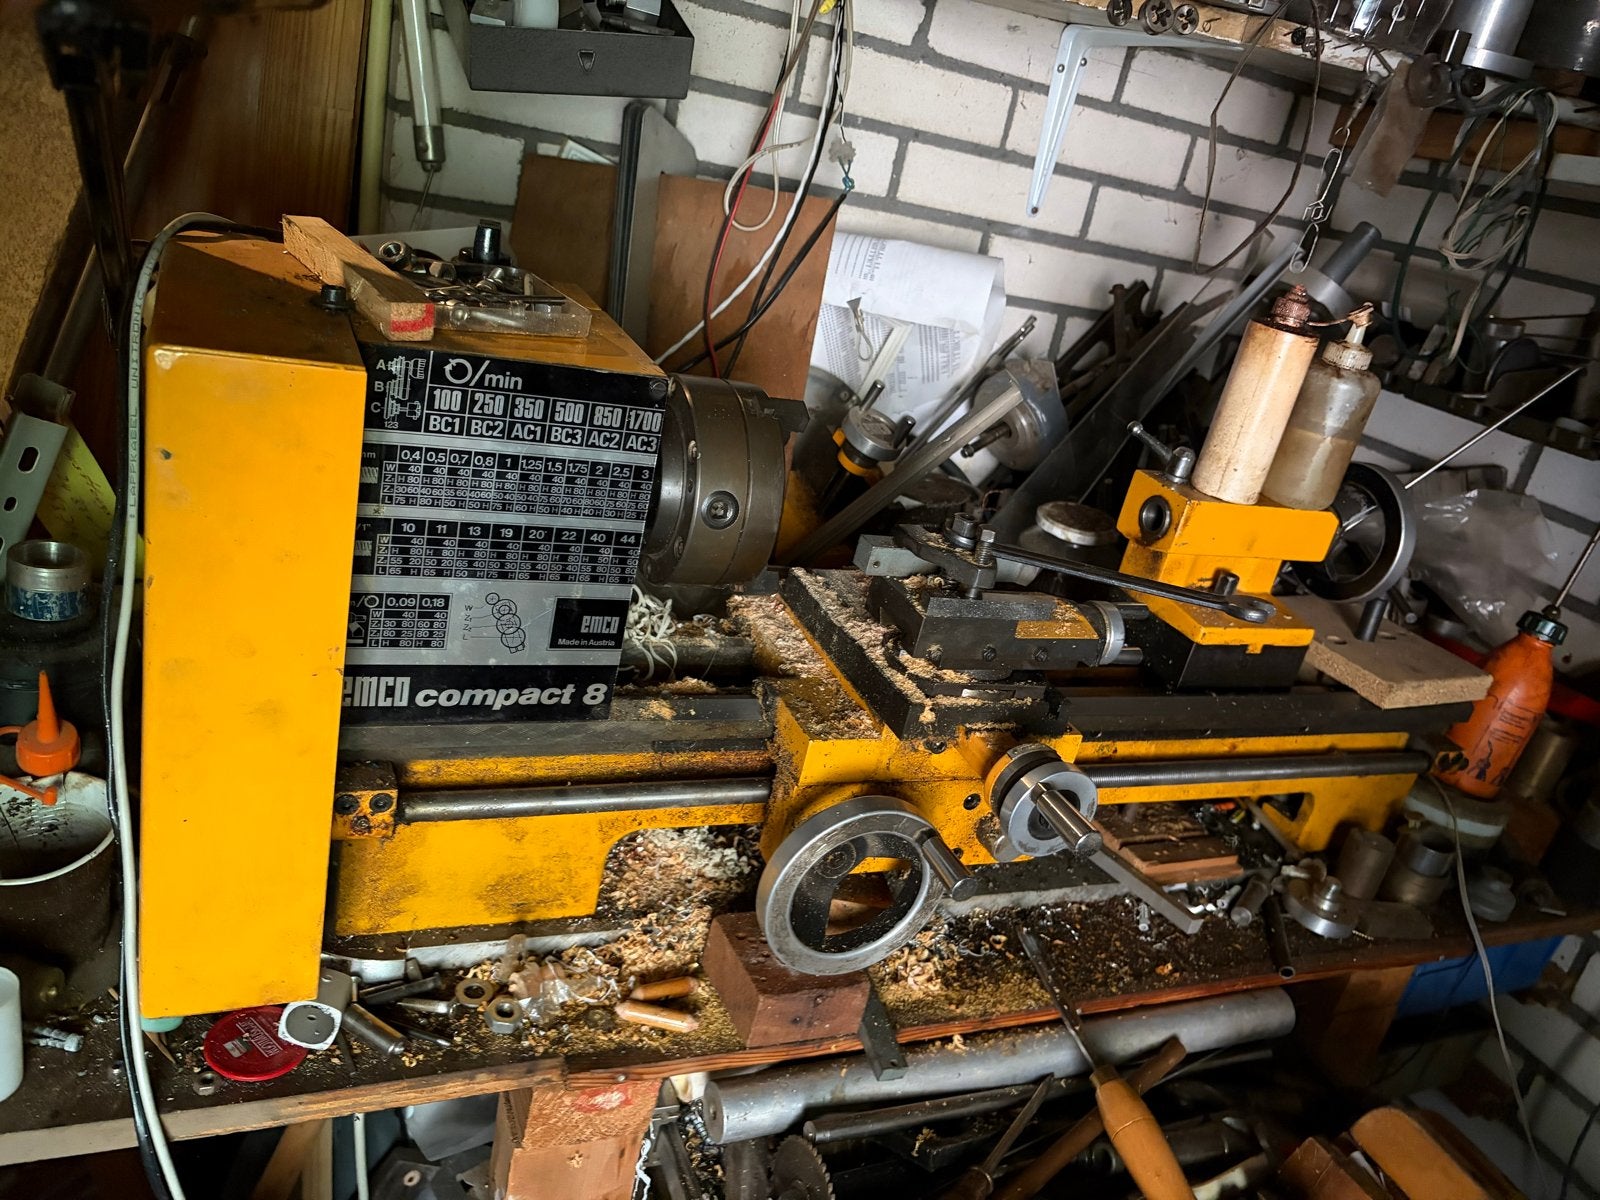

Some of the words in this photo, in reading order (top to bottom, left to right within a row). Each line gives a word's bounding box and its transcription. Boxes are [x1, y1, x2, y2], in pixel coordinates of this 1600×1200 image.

[131, 290, 146, 389] UNITRONIC
[376, 359, 386, 370] A
[374, 381, 384, 392] B
[371, 402, 381, 413] C
[433, 388, 462, 412] 100
[472, 392, 505, 416] 250
[513, 397, 545, 420] 350
[554, 401, 585, 424] 500
[593, 405, 622, 428] 850
[628, 409, 662, 433] 1700
[428, 415, 460, 434] BC1
[470, 419, 504, 437] BC2
[511, 423, 542, 441] AC1
[550, 426, 583, 445] BC3
[587, 431, 619, 449] AC2
[625, 435, 658, 452] AC3
[401, 450, 421, 462] 0,4
[426, 452, 446, 464] 0,5
[450, 453, 469, 465] 0,7
[474, 455, 494, 468] 0,8
[505, 458, 511, 467] 1
[521, 459, 543, 471] 1,25
[547, 461, 563, 472] 1,5
[568, 463, 588, 474] 1,75
[595, 465, 604, 475] 2
[612, 466, 630, 478] 2,5
[641, 469, 650, 479] 3
[385, 463, 396, 472] W
[408, 465, 421, 473] 40
[433, 467, 446, 475] 40
[457, 469, 470, 477] 40
[482, 471, 494, 479] 40
[505, 472, 518, 480] 40
[529, 474, 541, 482] 40
[574, 477, 586, 485] 40
[596, 479, 608, 487] 40
[618, 481, 630, 489] 40
[640, 483, 651, 491] 40
[407, 476, 420, 484] 80
[431, 477, 444, 485] 80
[455, 479, 468, 487] 80
[480, 481, 493, 489] 80
[504, 483, 516, 491] 80
[527, 484, 540, 492] 80
[550, 486, 562, 494] 80
[595, 489, 606, 497] 80
[616, 491, 628, 499] 80
[401, 523, 416, 533] 10
[436, 524, 448, 534] 11
[468, 526, 481, 536] 13
[500, 528, 514, 538] 19
[529, 529, 545, 540] 20
[561, 531, 577, 541] 22
[590, 533, 606, 543] 40
[620, 535, 635, 544] 44
[443, 539, 456, 547] 40
[538, 544, 551, 552] 40
[569, 545, 581, 553] 40
[599, 547, 611, 555] 40
[386, 597, 416, 607] 0,09
[421, 598, 445, 609] 0,18
[383, 620, 397, 628] 30
[417, 621, 430, 629] 60
[432, 621, 446, 629] 80
[382, 630, 396, 638] 80
[400, 630, 413, 638] 25
[416, 630, 430, 638] 80
[432, 630, 445, 638] 25
[399, 640, 412, 648] 80
[430, 640, 444, 648] 80
[558, 638, 578, 646] Made
[588, 639, 615, 647] Austria
[414, 683, 576, 711] compact
[582, 683, 608, 706] 8
